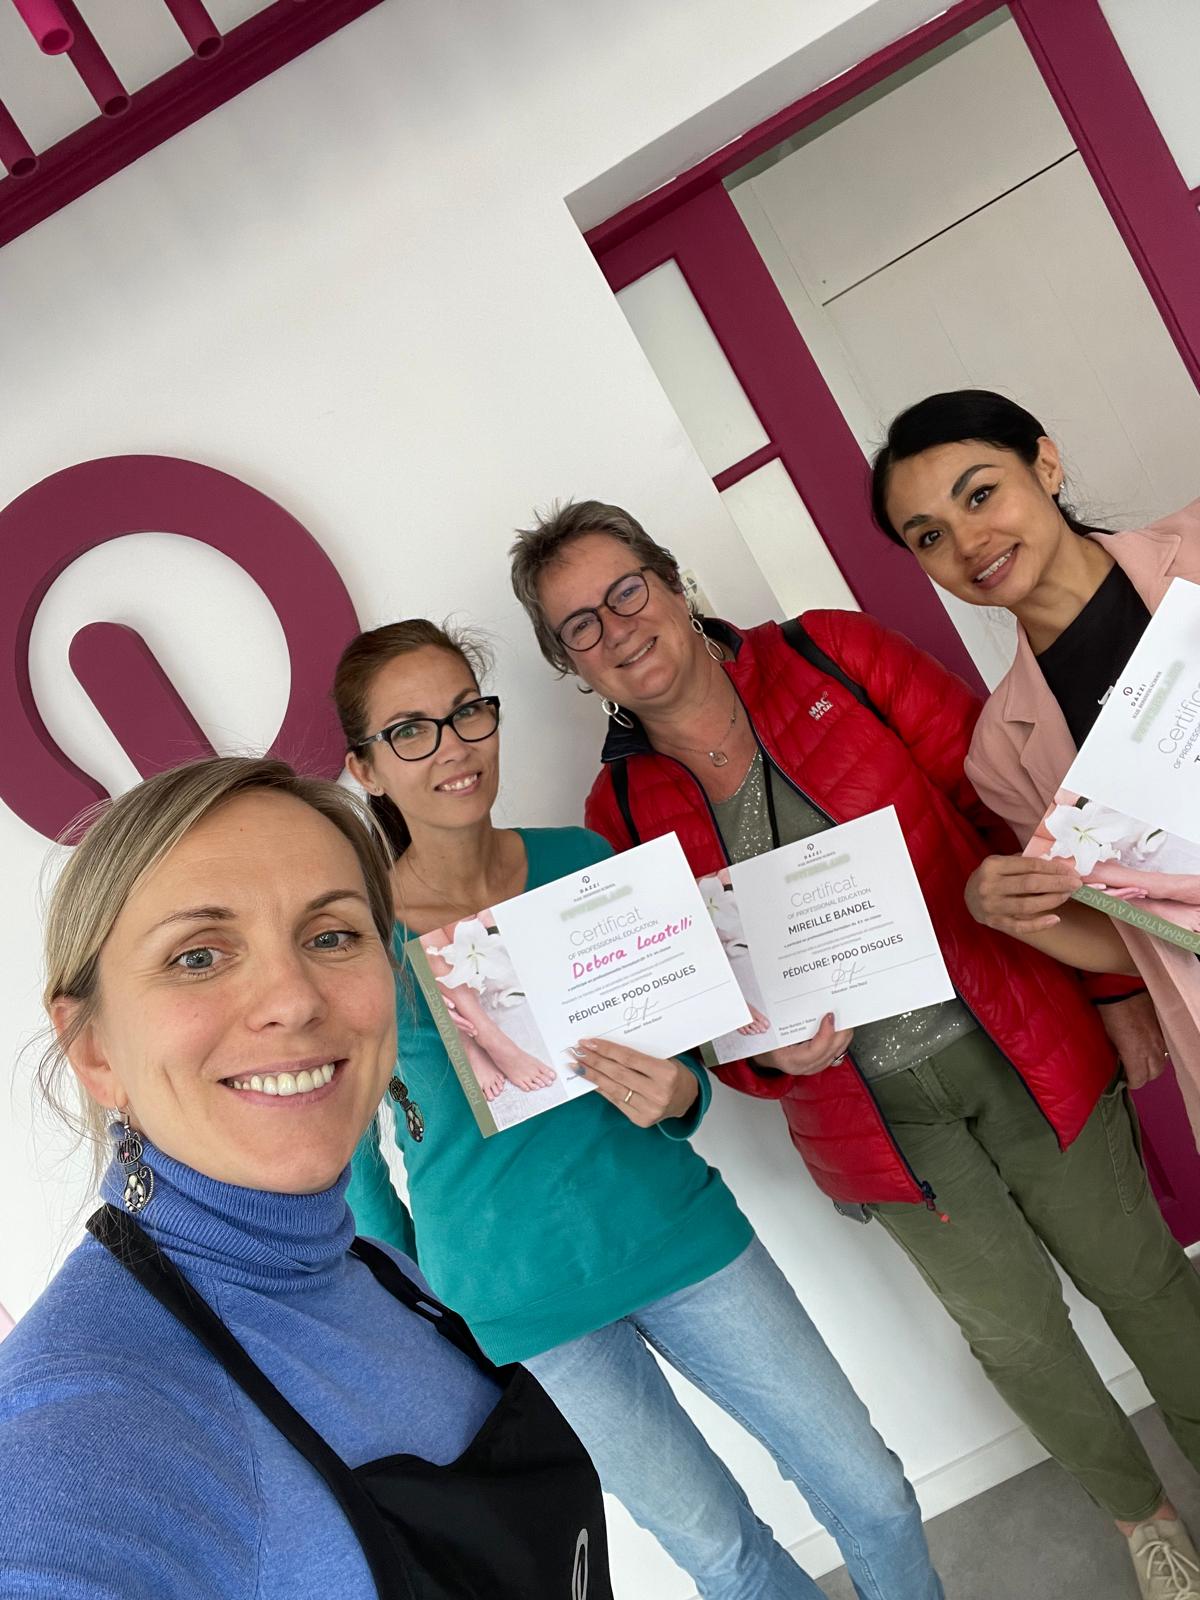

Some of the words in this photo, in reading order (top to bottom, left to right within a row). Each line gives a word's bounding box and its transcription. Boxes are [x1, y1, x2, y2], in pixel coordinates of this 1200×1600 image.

[1158, 682, 1200, 754] Certific
[790, 873, 858, 907] Certificat
[837, 887, 872, 903] EDUCATION
[569, 906, 644, 946] Certificat
[623, 920, 658, 938] EDUCATION
[788, 913, 833, 935] MIREILLE
[833, 900, 876, 920] BANDEL
[572, 948, 627, 979] Debora
[637, 914, 693, 950] Locatelli
[831, 948, 859, 964] PODO
[860, 934, 904, 954] DISQUES
[621, 983, 651, 1002] PODO
[651, 964, 697, 989] DISQUES
